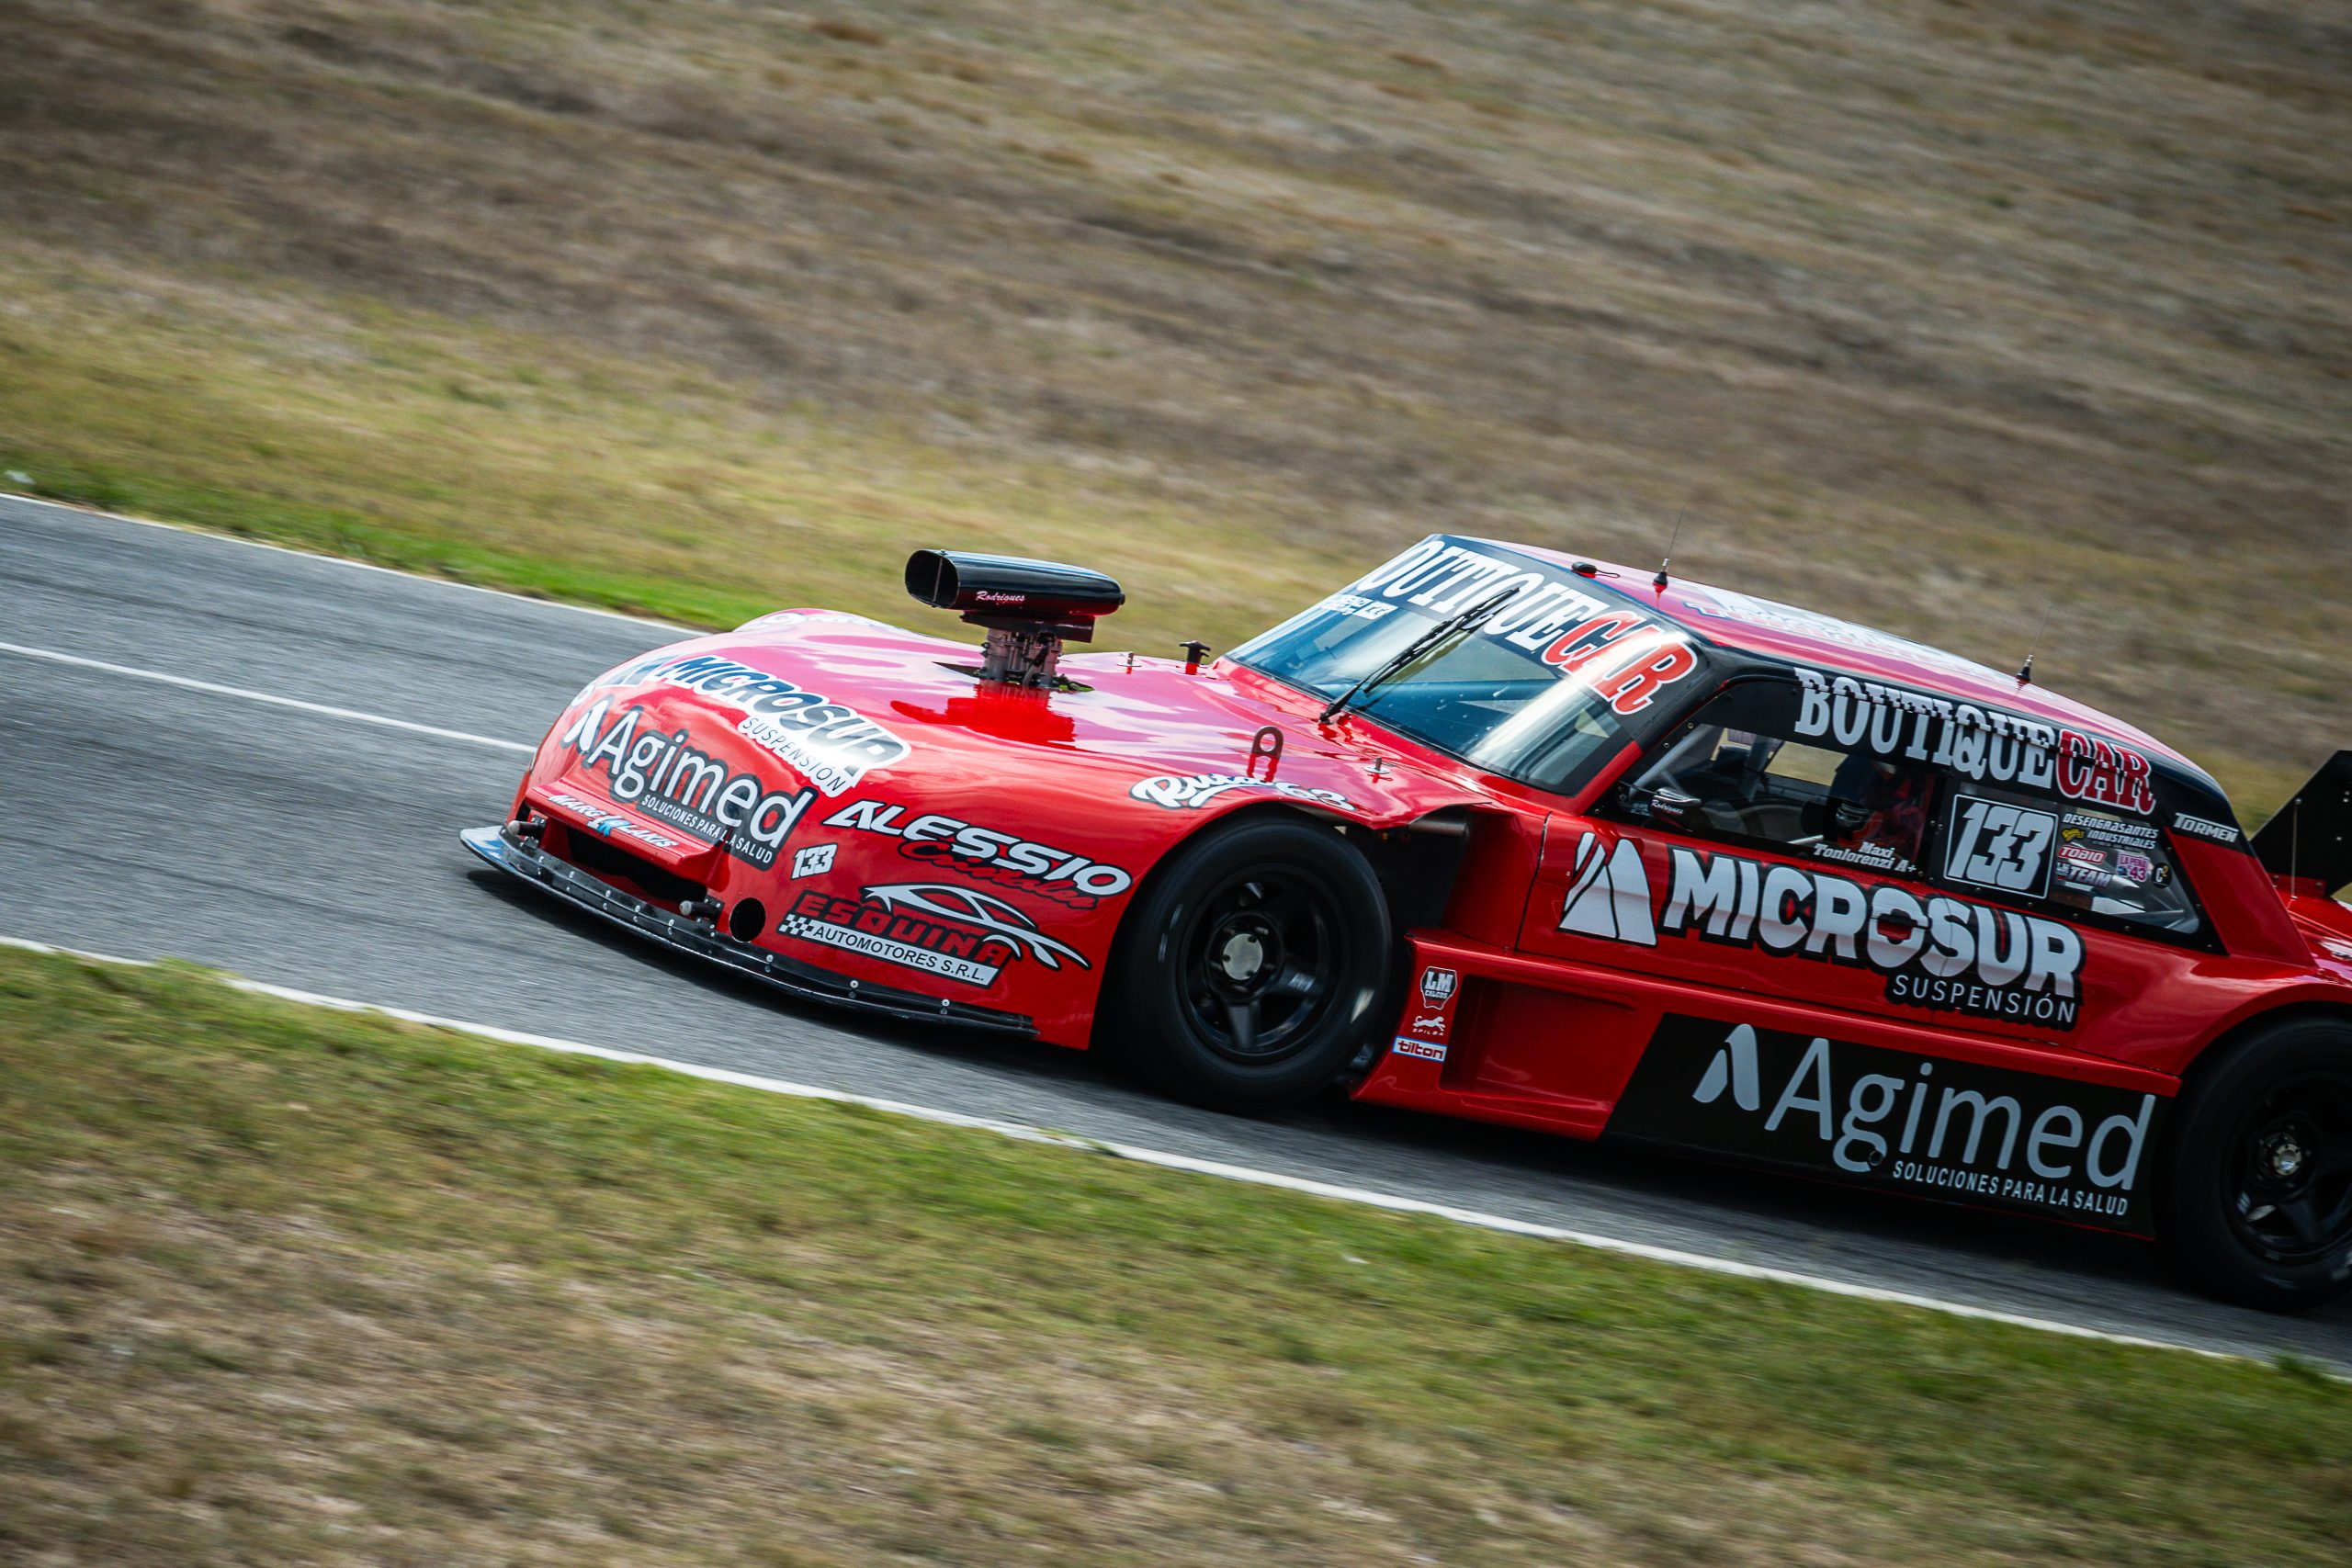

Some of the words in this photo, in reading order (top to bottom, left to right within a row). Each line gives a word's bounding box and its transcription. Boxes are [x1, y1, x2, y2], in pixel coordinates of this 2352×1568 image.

[976, 591, 1025, 604] Rodrigues
[656, 656, 905, 778] MICROSUR
[587, 710, 814, 849] Agimed
[741, 716, 847, 793] SUSPENSIÓN
[641, 794, 698, 828] SOLUCIONES
[695, 818, 721, 838] PARA
[735, 837, 773, 863] SALUD
[823, 800, 1133, 896] ALESSIO
[1859, 841, 1895, 858] Maxi
[1947, 802, 2054, 890] 133
[2174, 812, 2240, 843] TORMEN
[791, 843, 838, 879] 133
[1814, 842, 1895, 870] Tonlorenzi
[1894, 859, 1917, 873] A+
[2068, 865, 2112, 887] TEAM
[796, 893, 1012, 966] ESQUINA
[1664, 848, 2083, 998] MICROSUR
[812, 926, 938, 969] AUTOMOTORES
[940, 959, 985, 982] S.R.L.
[1424, 971, 1453, 992] LM
[1893, 974, 2075, 1023] SUSPENSIÓN
[1398, 1040, 1444, 1059] tilton
[1764, 1037, 2156, 1190] Agimed
[1893, 1160, 2000, 1194] SOLUCIONES
[2002, 1179, 2044, 1202] PARA
[2048, 1186, 2069, 1207] LA
[2073, 1190, 2129, 1216] SALUD
